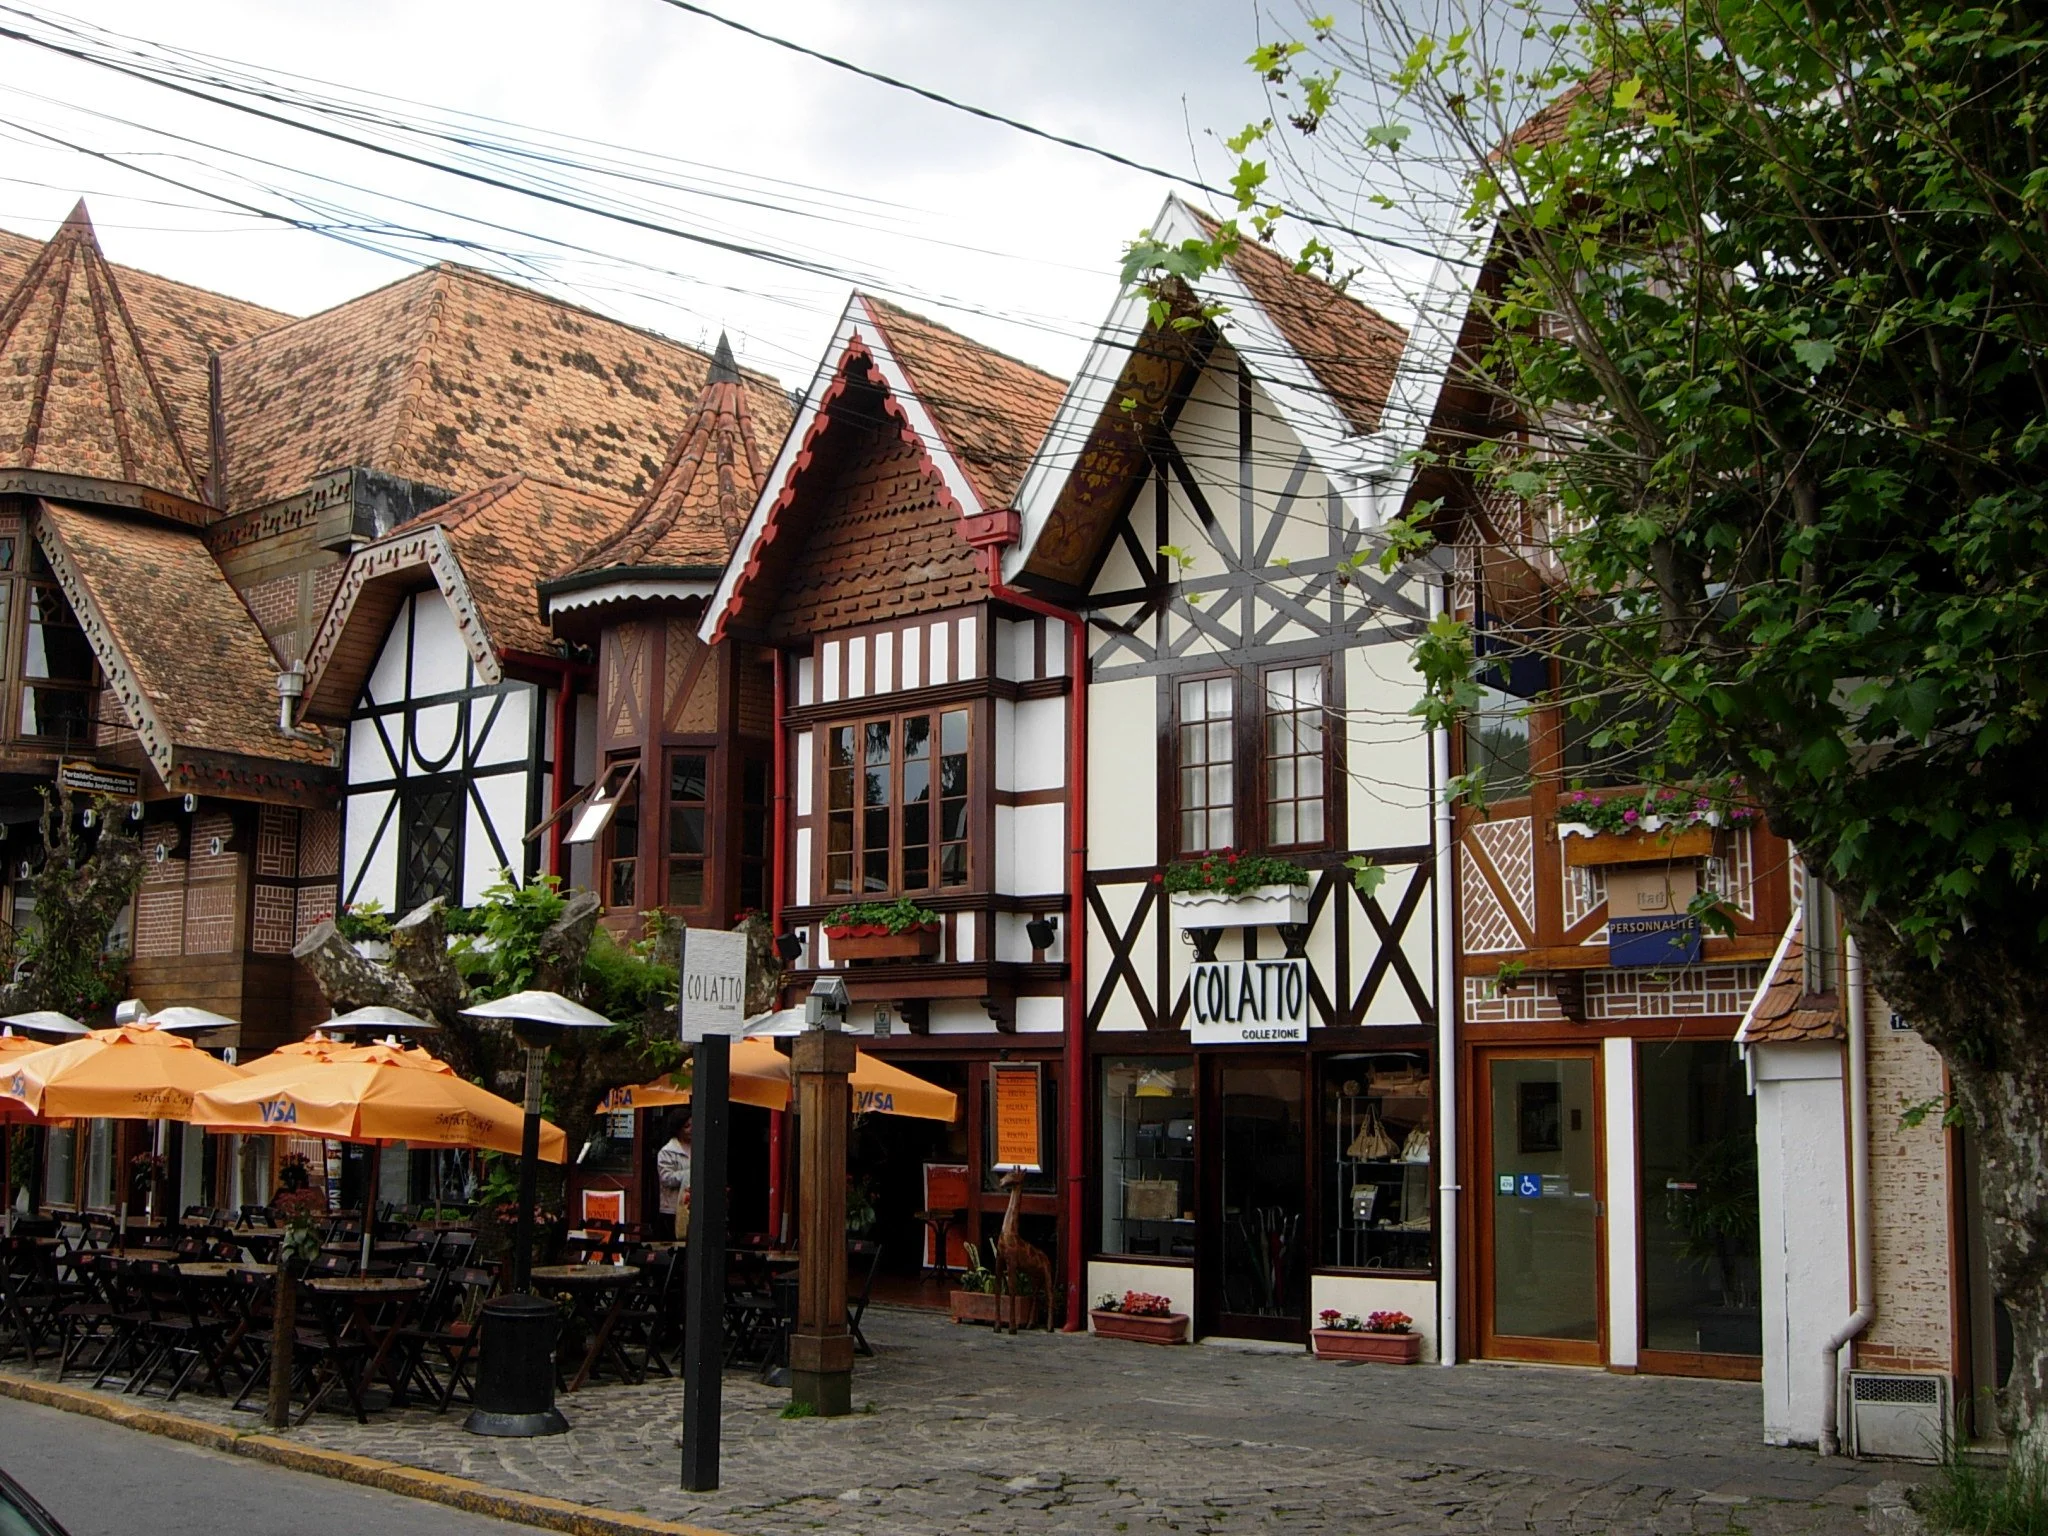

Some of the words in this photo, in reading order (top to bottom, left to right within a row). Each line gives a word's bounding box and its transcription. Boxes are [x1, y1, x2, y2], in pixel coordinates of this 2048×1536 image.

[687, 974, 742, 1003] COLATTO
[1193, 961, 1303, 1025] COLATTO
[1242, 1028, 1300, 1040] COLLEZIONE
[257, 1101, 297, 1123] VISA
[857, 1091, 894, 1111] VISA
